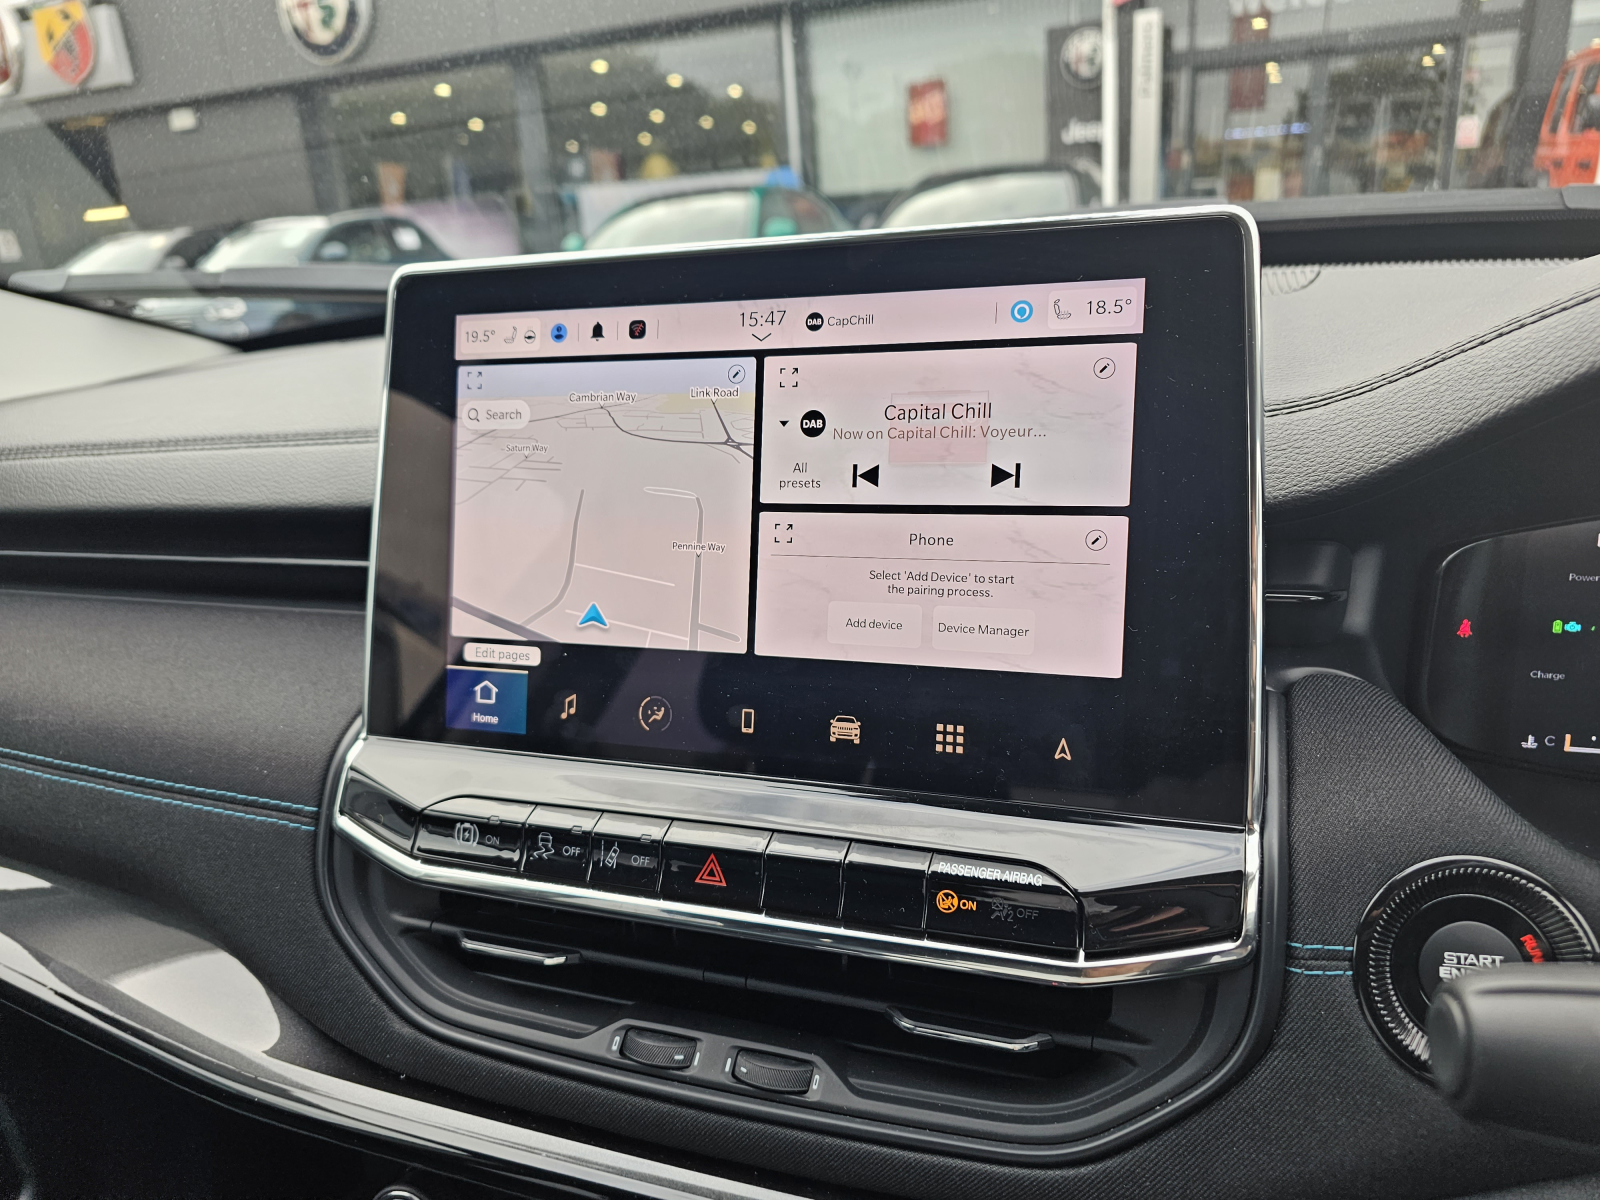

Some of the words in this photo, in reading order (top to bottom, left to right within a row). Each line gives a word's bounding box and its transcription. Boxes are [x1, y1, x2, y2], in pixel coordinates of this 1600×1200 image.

[1087, 299, 1132, 315] 18.5°
[739, 310, 786, 328] 15:47
[807, 317, 822, 326] DAB
[828, 313, 874, 328] CapChill
[465, 329, 496, 344] 19.5°
[569, 392, 614, 403] Cambrian
[616, 392, 636, 404] Way
[690, 387, 711, 398] Link
[713, 387, 739, 398] Road
[485, 409, 522, 421] Search
[884, 403, 946, 423] Capital
[951, 403, 992, 420] Chill
[802, 418, 823, 429] DAB
[833, 428, 862, 441] Now
[866, 430, 883, 440] on
[887, 427, 937, 443] Capital
[940, 426, 977, 439] Chill:
[506, 444, 530, 453] Saturn
[532, 444, 548, 454] Way
[793, 463, 807, 474] All
[779, 477, 821, 489] presets
[909, 533, 954, 547] Phone
[672, 542, 706, 551] Pennine
[707, 543, 725, 553] Way
[869, 570, 901, 582] Select
[904, 571, 928, 582] 'Add
[931, 571, 971, 583] Device'
[974, 574, 986, 584] to
[988, 574, 1014, 584] start
[887, 585, 905, 595] the
[907, 585, 945, 598] pairing
[947, 588, 994, 599] process.
[846, 618, 866, 629] Add
[869, 618, 903, 631] device
[938, 623, 975, 635] Device
[978, 624, 1029, 639] Manager
[475, 647, 496, 659] Edit
[498, 650, 530, 662] pages
[1530, 670, 1565, 681] Charge
[472, 712, 499, 724] Home
[1545, 735, 1556, 746] C
[485, 835, 500, 845] ON
[562, 846, 581, 857] OFF
[631, 855, 650, 866] OFF
[938, 862, 1001, 880] PASSENGER
[1002, 872, 1043, 886] AIRBAG
[960, 899, 977, 911] ON
[1016, 908, 1039, 920] OFF
[1520, 934, 1544, 963] RUN
[1444, 951, 1504, 968] START
